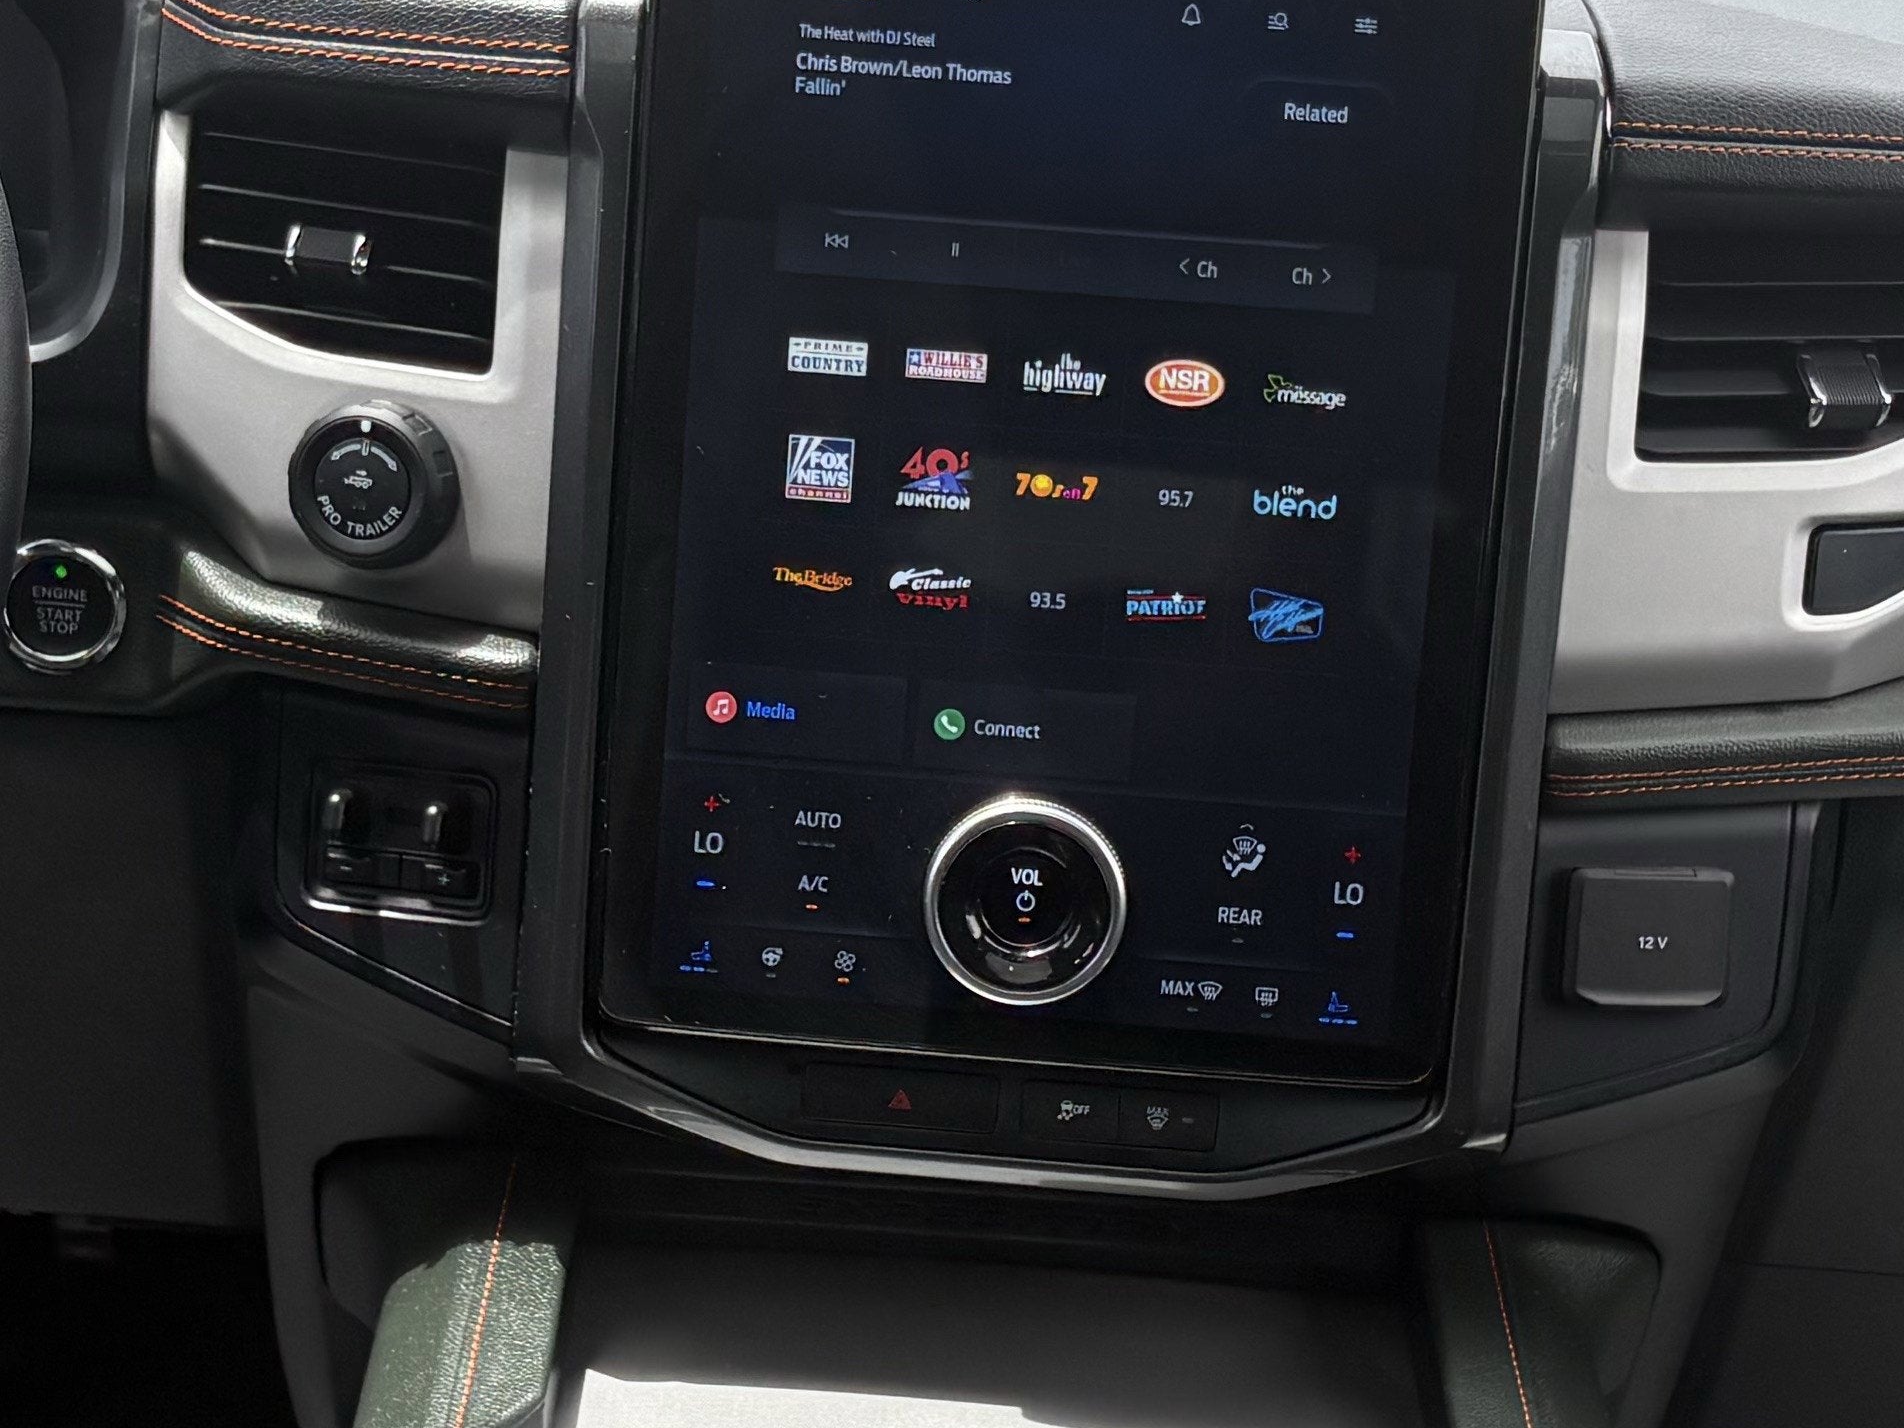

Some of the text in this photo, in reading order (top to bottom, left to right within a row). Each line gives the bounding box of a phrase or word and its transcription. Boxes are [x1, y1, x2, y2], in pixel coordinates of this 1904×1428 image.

[799, 23, 936, 48] The Heat with DJ Steel
[796, 52, 1012, 85] Chris Brown/Leon Thomas
[795, 76, 846, 97] Fallin'
[1283, 101, 1349, 125] Related
[1197, 259, 1313, 285] Ch Ch
[803, 341, 853, 353] PRIME
[790, 355, 865, 374] COUNTRY
[921, 350, 984, 369] WILLIE'S
[908, 364, 985, 382] ROADHOUSE
[1022, 360, 1107, 397] highway
[1159, 368, 1211, 393] NSR
[809, 450, 850, 471] FOX
[797, 468, 850, 487] NEWS
[895, 491, 971, 511] JUNCTION
[1158, 489, 1195, 508] 95.7
[1253, 486, 1338, 521] blend
[317, 495, 342, 526] PRO
[346, 506, 403, 537] TRAILER
[31, 584, 88, 602] ENGINE
[910, 575, 972, 591] Classic
[1028, 591, 1067, 610] 93.5
[1126, 599, 1207, 616] PATRIOT
[36, 606, 83, 623] START
[39, 620, 79, 634] STOP
[746, 700, 797, 721] Media
[973, 719, 1042, 740] Connect
[795, 811, 842, 830] AUTO
[693, 830, 724, 855] LO
[797, 875, 829, 894] A/C
[1010, 867, 1044, 887] VOL
[1333, 881, 1365, 906] LO
[1217, 906, 1263, 927] REAR
[1638, 936, 1668, 949] 12 V
[1160, 979, 1195, 998] MAX
[1072, 1103, 1091, 1116] OFF
